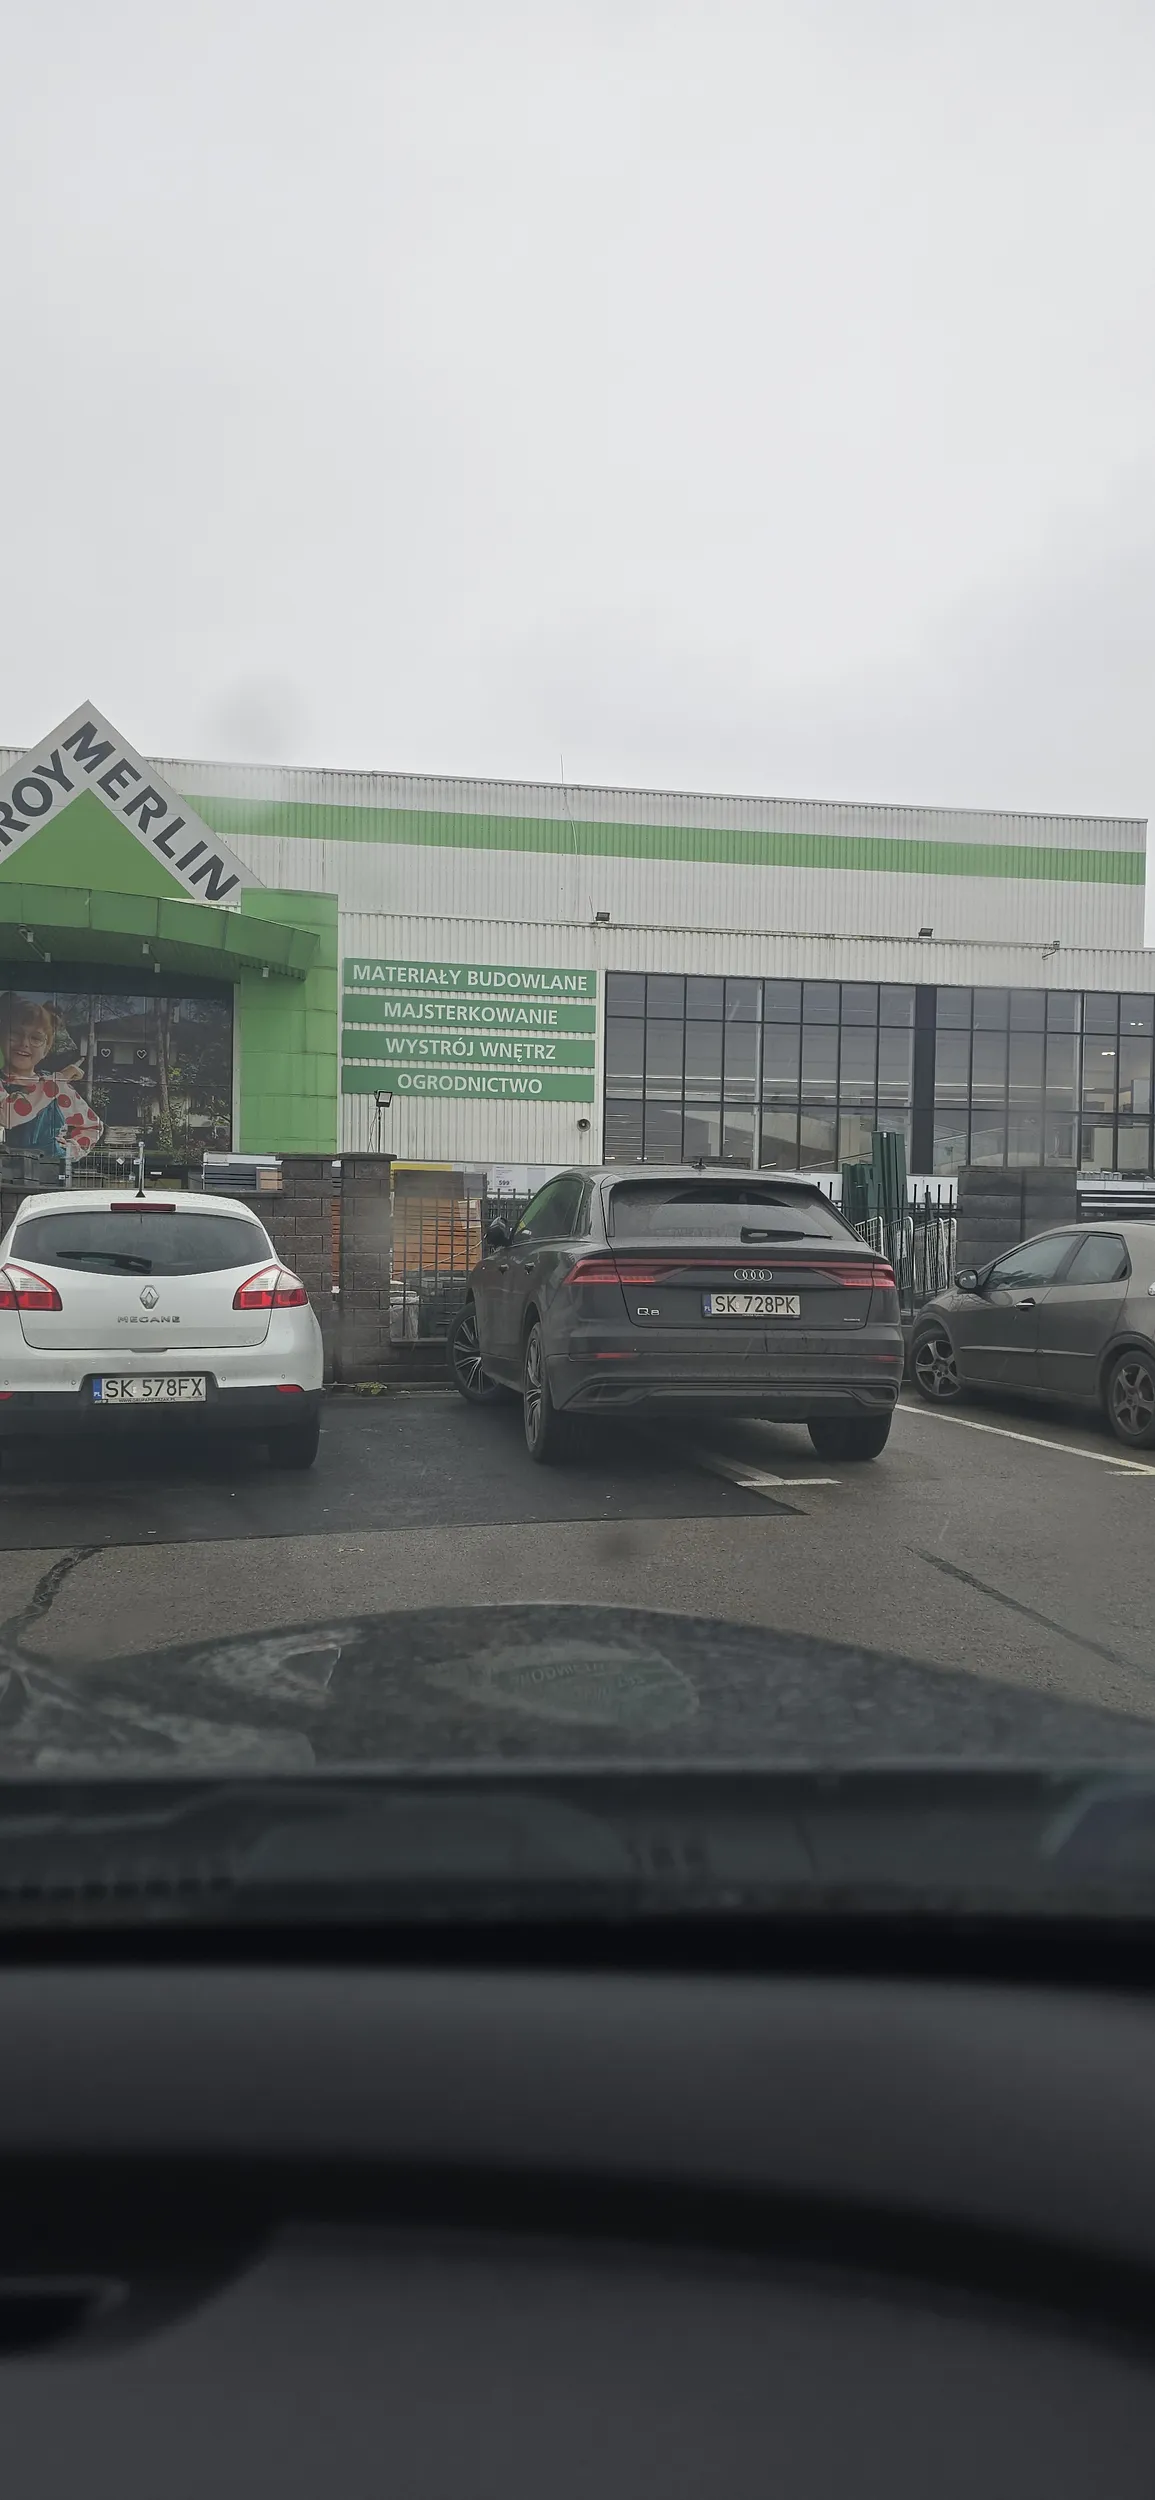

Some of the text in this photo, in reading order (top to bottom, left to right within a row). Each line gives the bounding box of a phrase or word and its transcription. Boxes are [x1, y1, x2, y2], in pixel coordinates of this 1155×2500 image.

[61, 721, 240, 901] MERLIN
[353, 964, 587, 991] MATERIAŁY BUDOWLANE
[384, 1002, 558, 1025] MAJSTERKOWANIE
[386, 1037, 556, 1062] WYSTRÓJ WNĘTRZ
[397, 1073, 543, 1094] OGRODNICTWO
[637, 1307, 660, 1316] Q8
[715, 1295, 737, 1313] SK
[743, 1296, 796, 1314] 728PK
[117, 1315, 181, 1324] MEGANE
[105, 1379, 134, 1398] SK
[142, 1378, 203, 1397] 578FX
